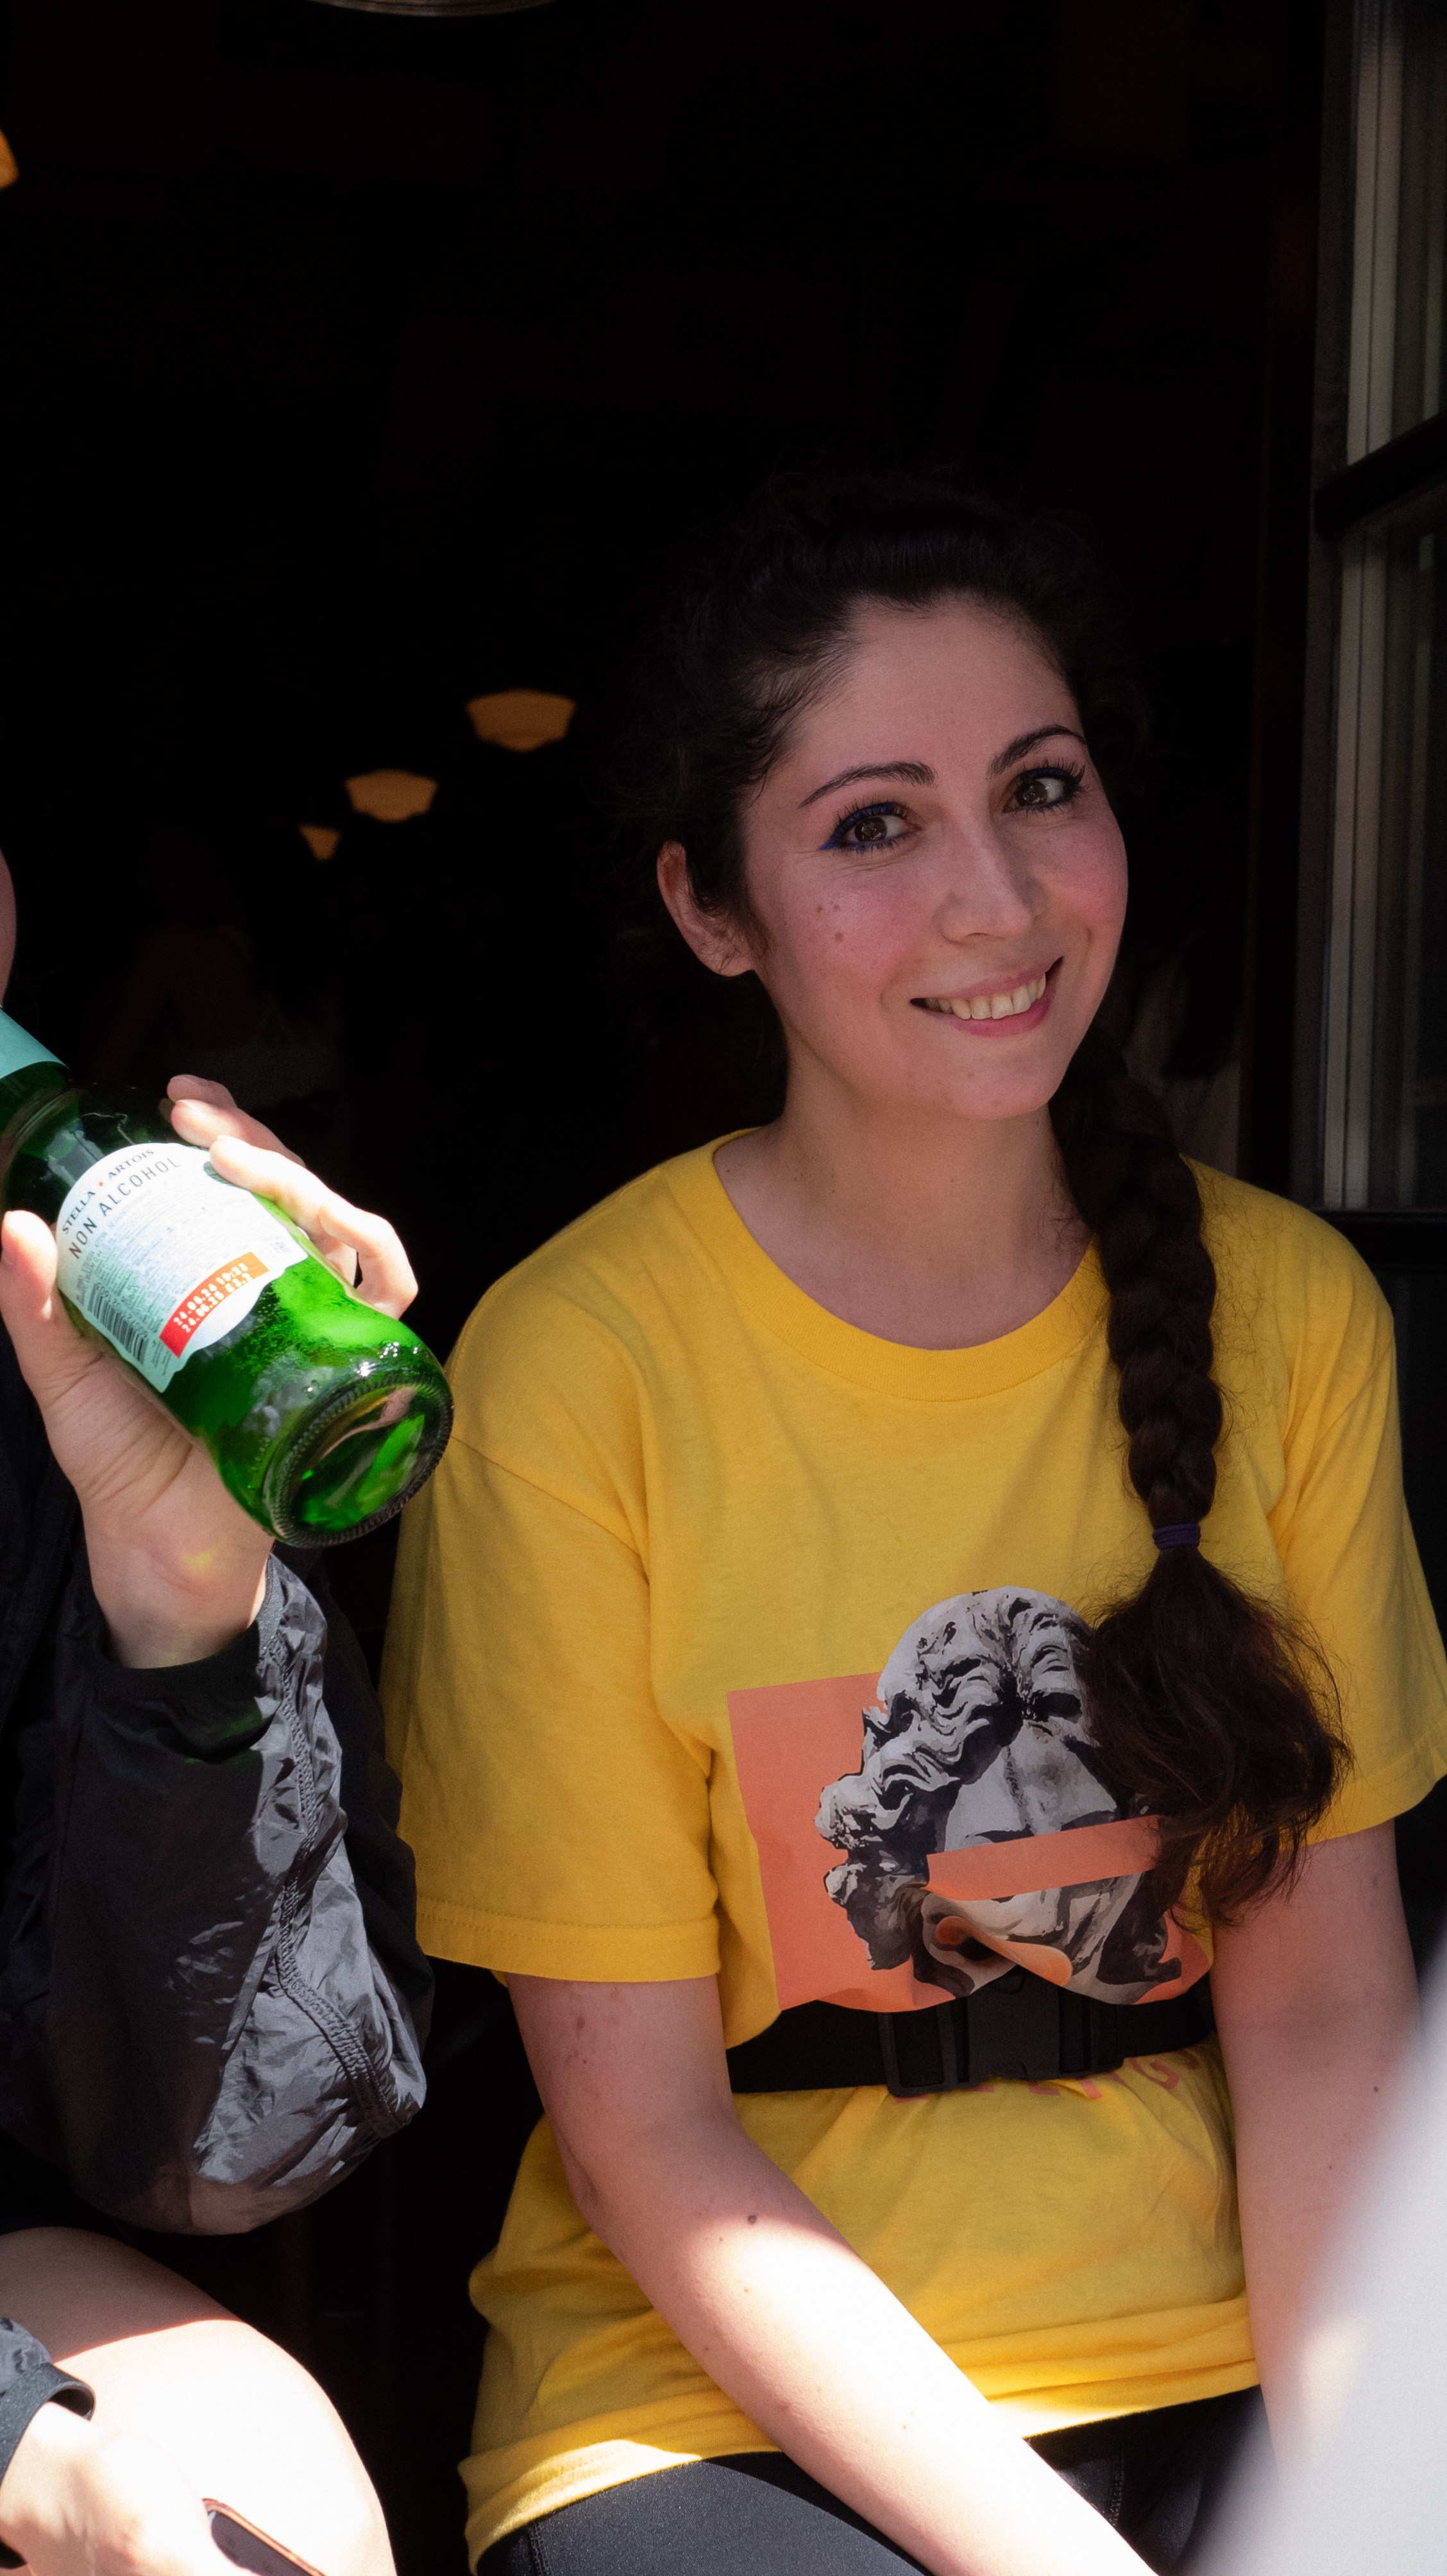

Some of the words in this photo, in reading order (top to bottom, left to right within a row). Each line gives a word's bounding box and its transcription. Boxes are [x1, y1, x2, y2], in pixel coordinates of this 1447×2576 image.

[62, 1191, 96, 1234] STELLA
[108, 1149, 154, 1179] ARTOIS
[69, 1217, 97, 1258] NON
[99, 1158, 181, 1216] ALCOHOL
